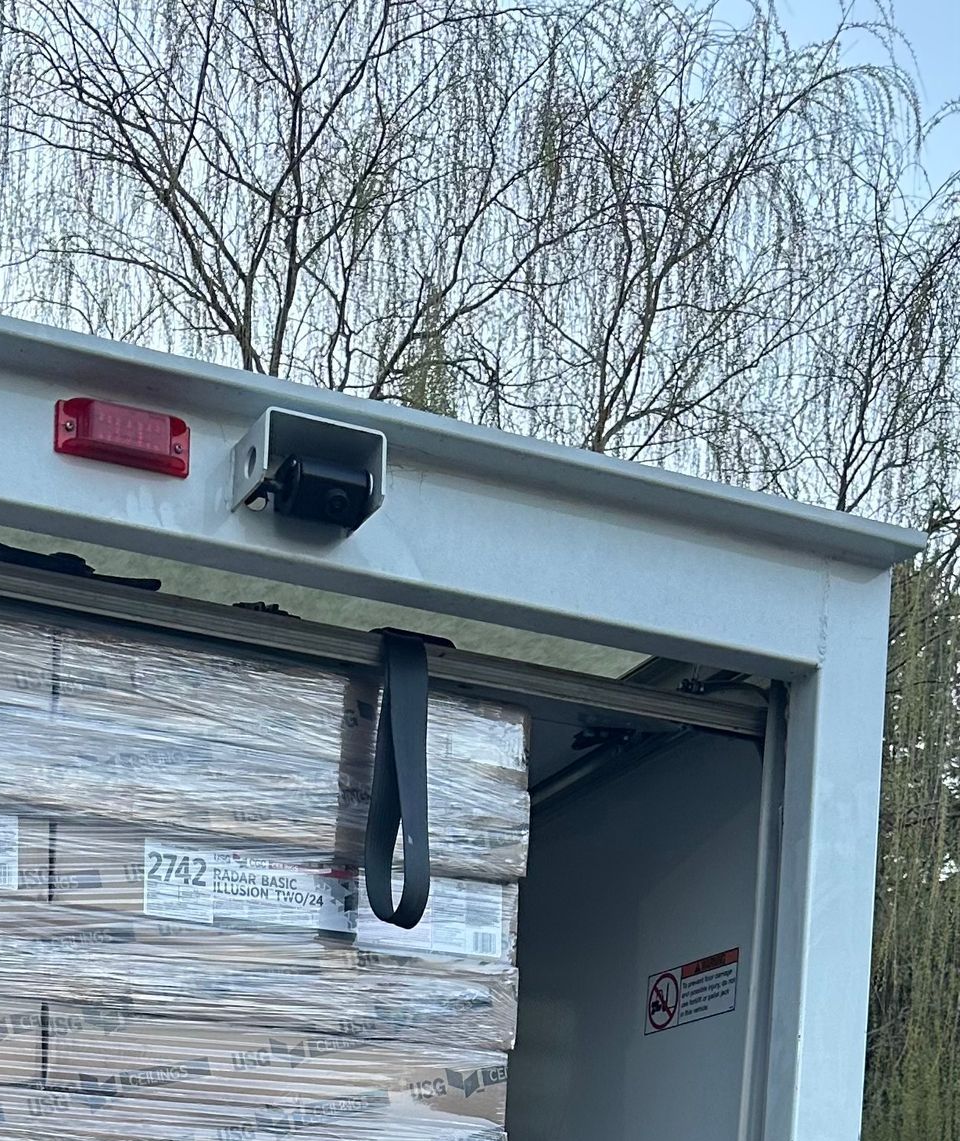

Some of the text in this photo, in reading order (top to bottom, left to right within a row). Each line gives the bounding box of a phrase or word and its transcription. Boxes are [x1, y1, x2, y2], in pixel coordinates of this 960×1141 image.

[147, 851, 207, 886] 2742
[213, 868, 297, 890] RADAR BASIC
[213, 881, 324, 907] ILLUSION TWO/24
[232, 1050, 270, 1070] USG
[128, 1064, 189, 1087] CEILINGS
[409, 1077, 447, 1100] USG
